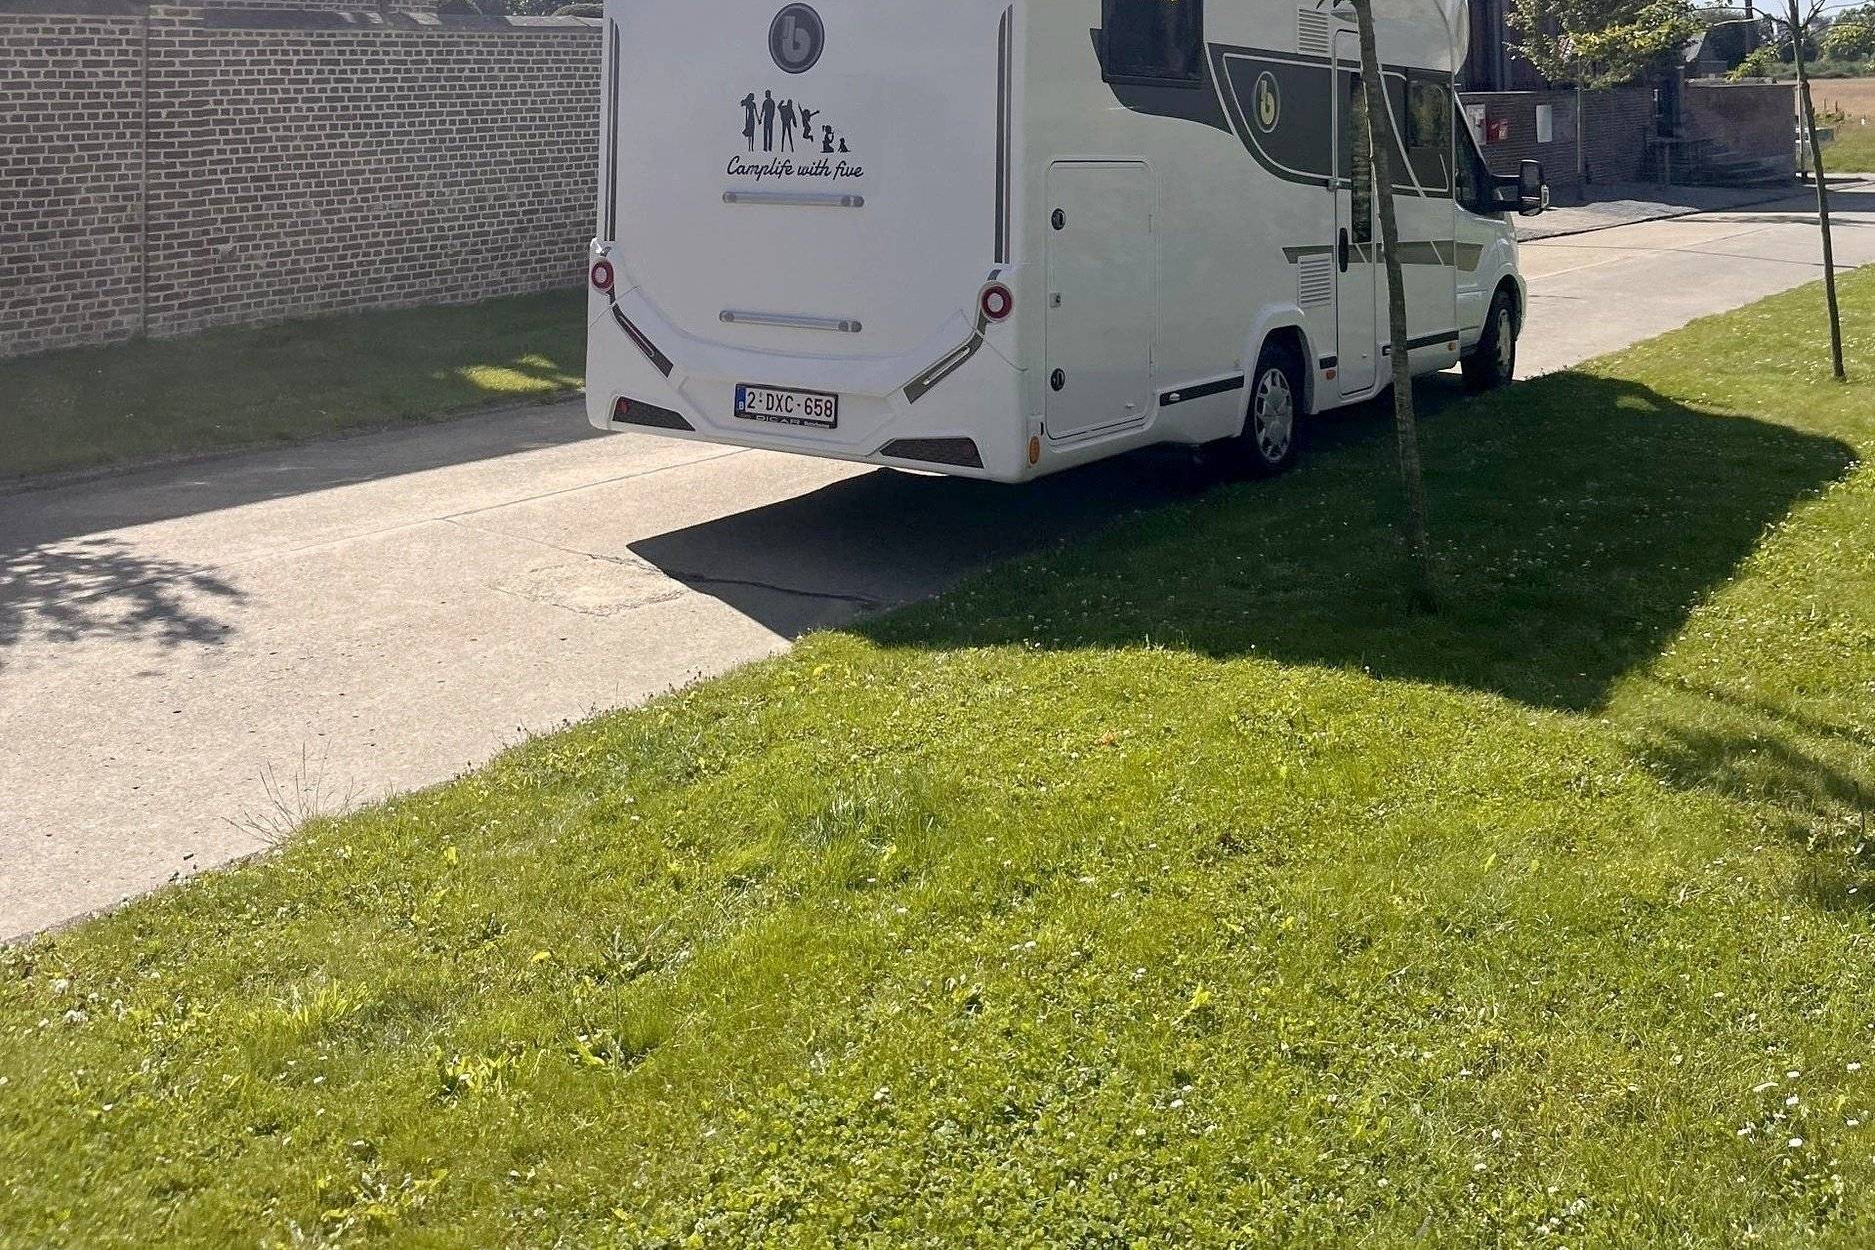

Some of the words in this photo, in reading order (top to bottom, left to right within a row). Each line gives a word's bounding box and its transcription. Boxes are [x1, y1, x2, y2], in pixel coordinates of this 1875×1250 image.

[727, 155, 794, 181] Camplife
[797, 158, 831, 177] with
[833, 160, 864, 180] five
[738, 400, 745, 410] B
